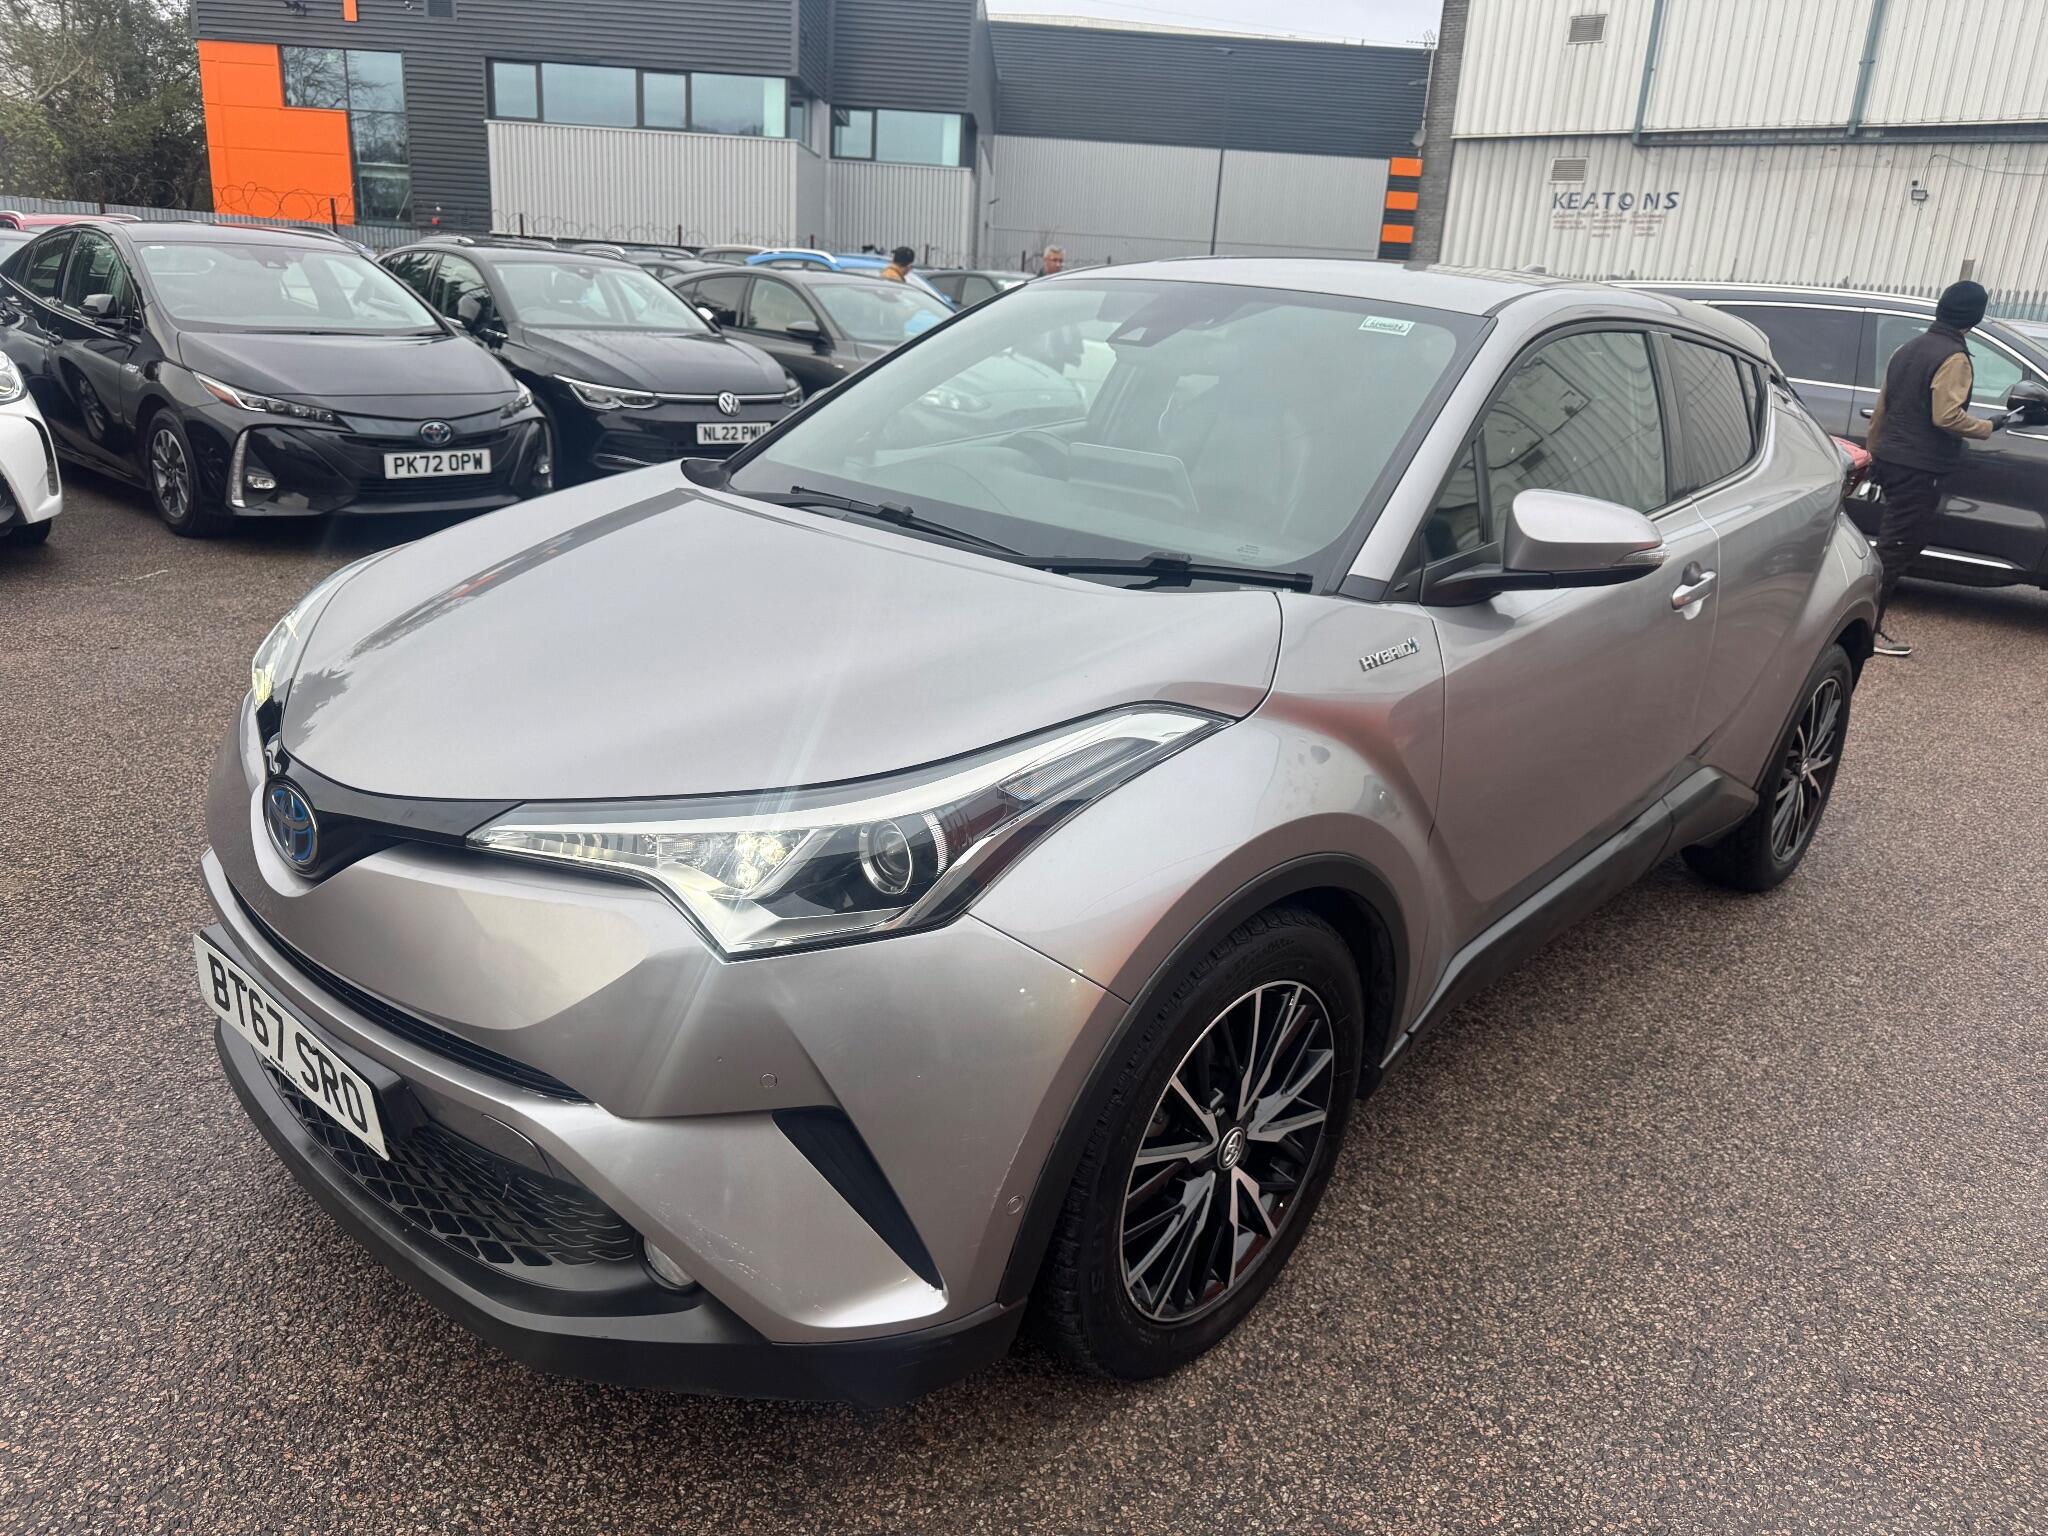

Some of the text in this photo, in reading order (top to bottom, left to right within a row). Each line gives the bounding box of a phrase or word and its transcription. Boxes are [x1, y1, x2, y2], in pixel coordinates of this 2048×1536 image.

[1552, 191, 1680, 211] KEATONS
[703, 426, 739, 441] NL22
[393, 453, 483, 475] PK72 OPW
[1359, 642, 1413, 672] HYBRID
[208, 952, 369, 1134] BT67 SRO
